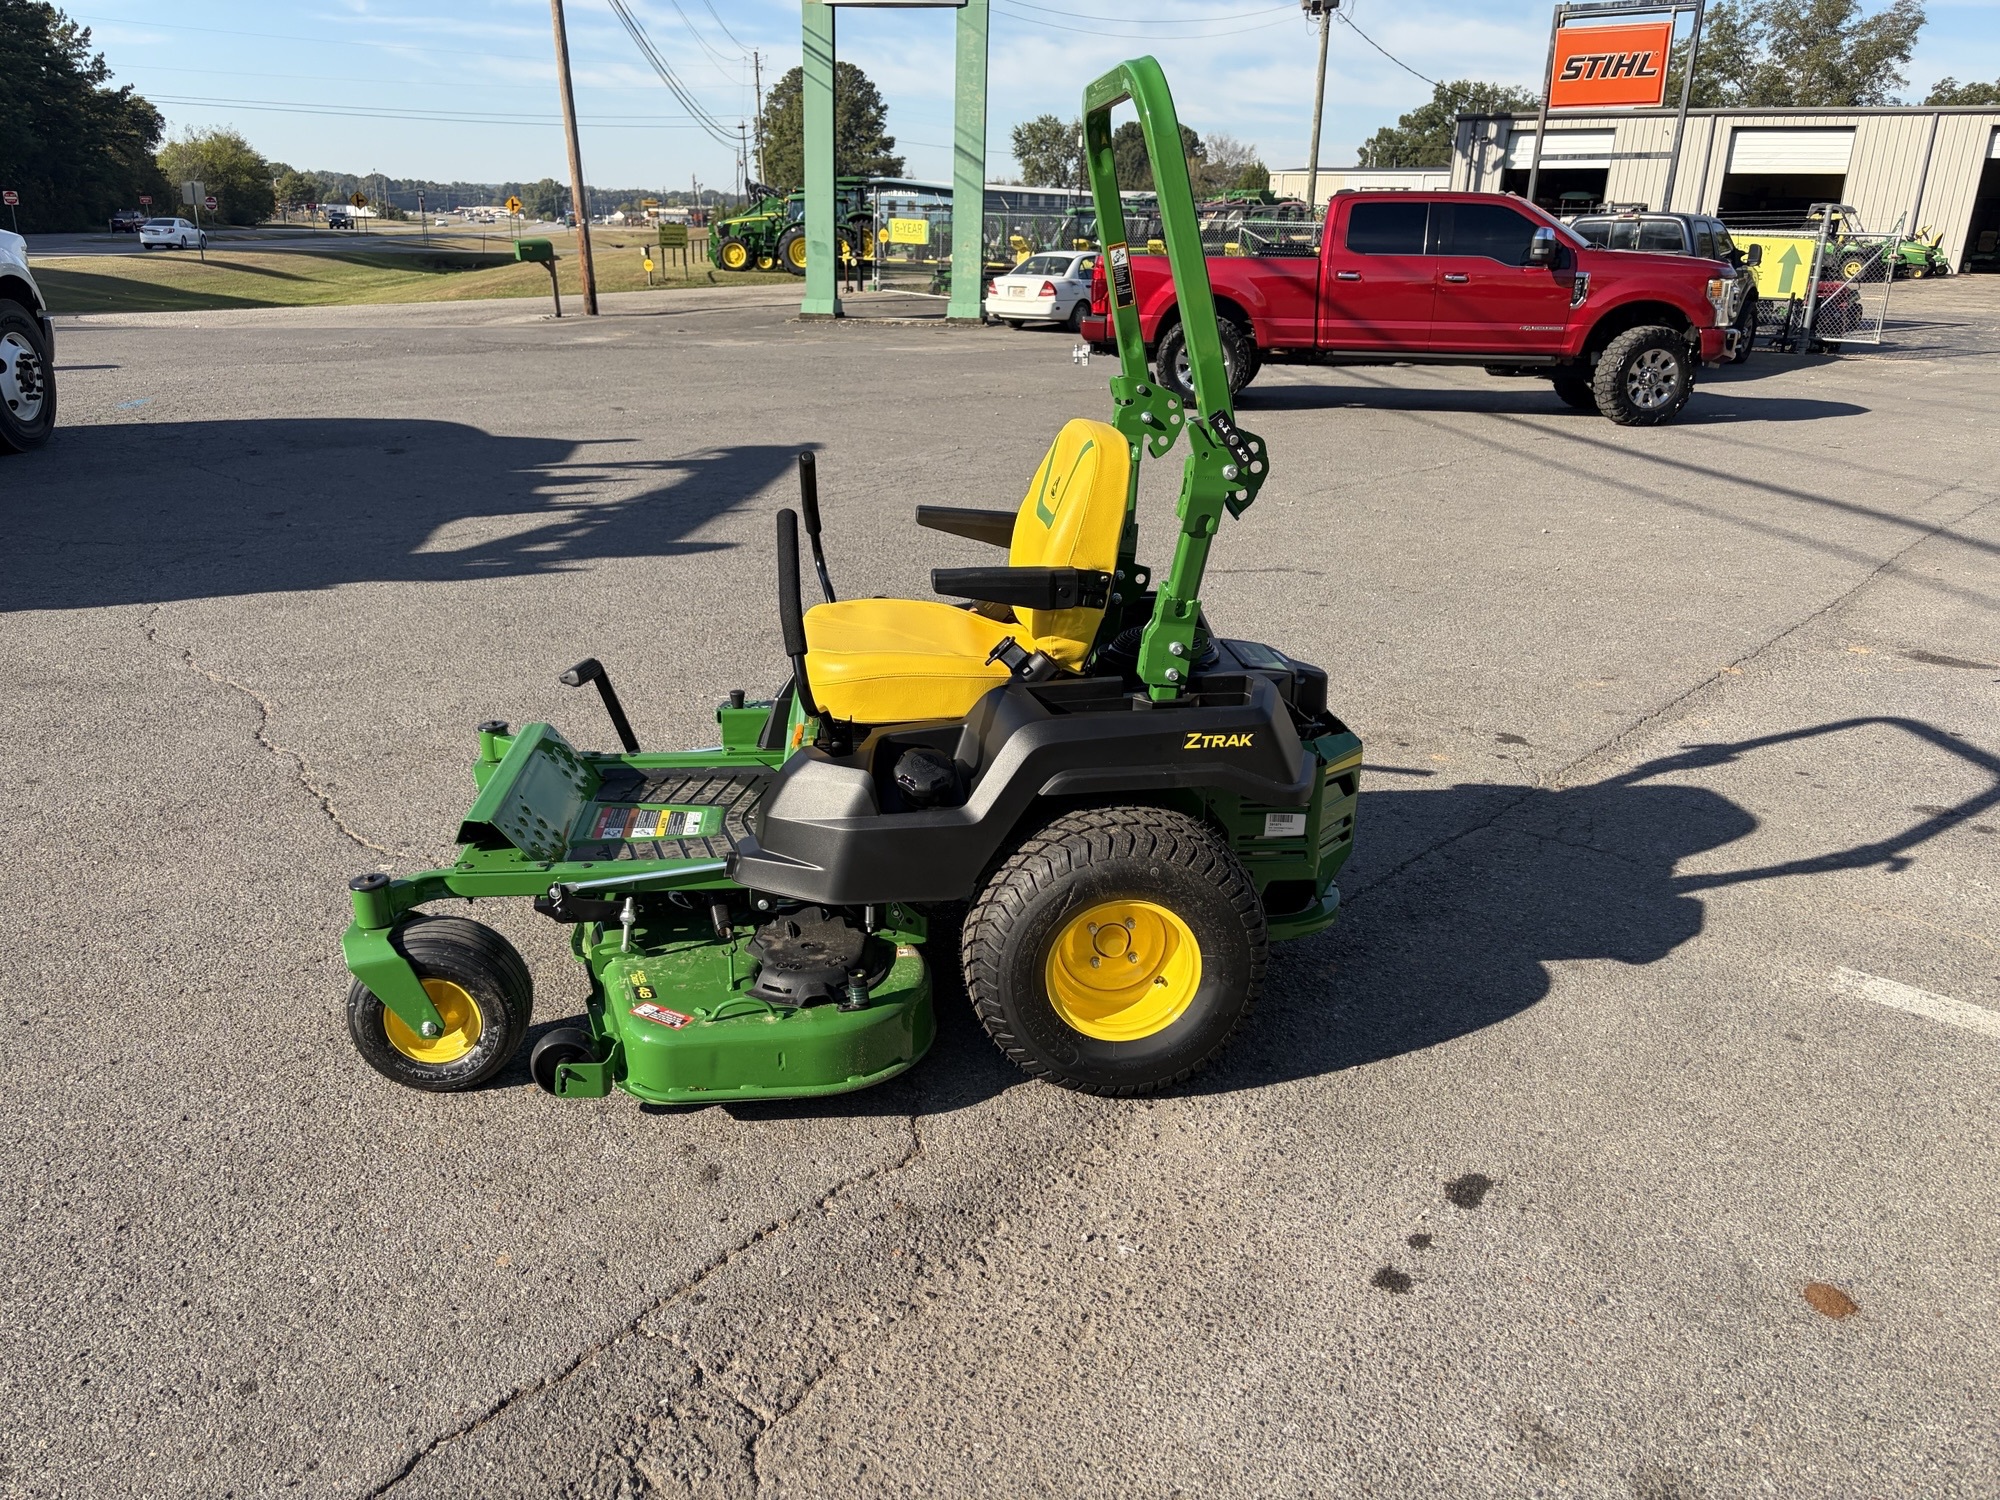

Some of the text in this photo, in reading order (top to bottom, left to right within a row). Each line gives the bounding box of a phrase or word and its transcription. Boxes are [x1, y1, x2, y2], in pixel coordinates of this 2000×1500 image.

[1559, 51, 1658, 81] STIHL
[894, 222, 923, 234] 6-YEAR
[1184, 733, 1254, 749] ZTRAK
[638, 986, 652, 999] 48
